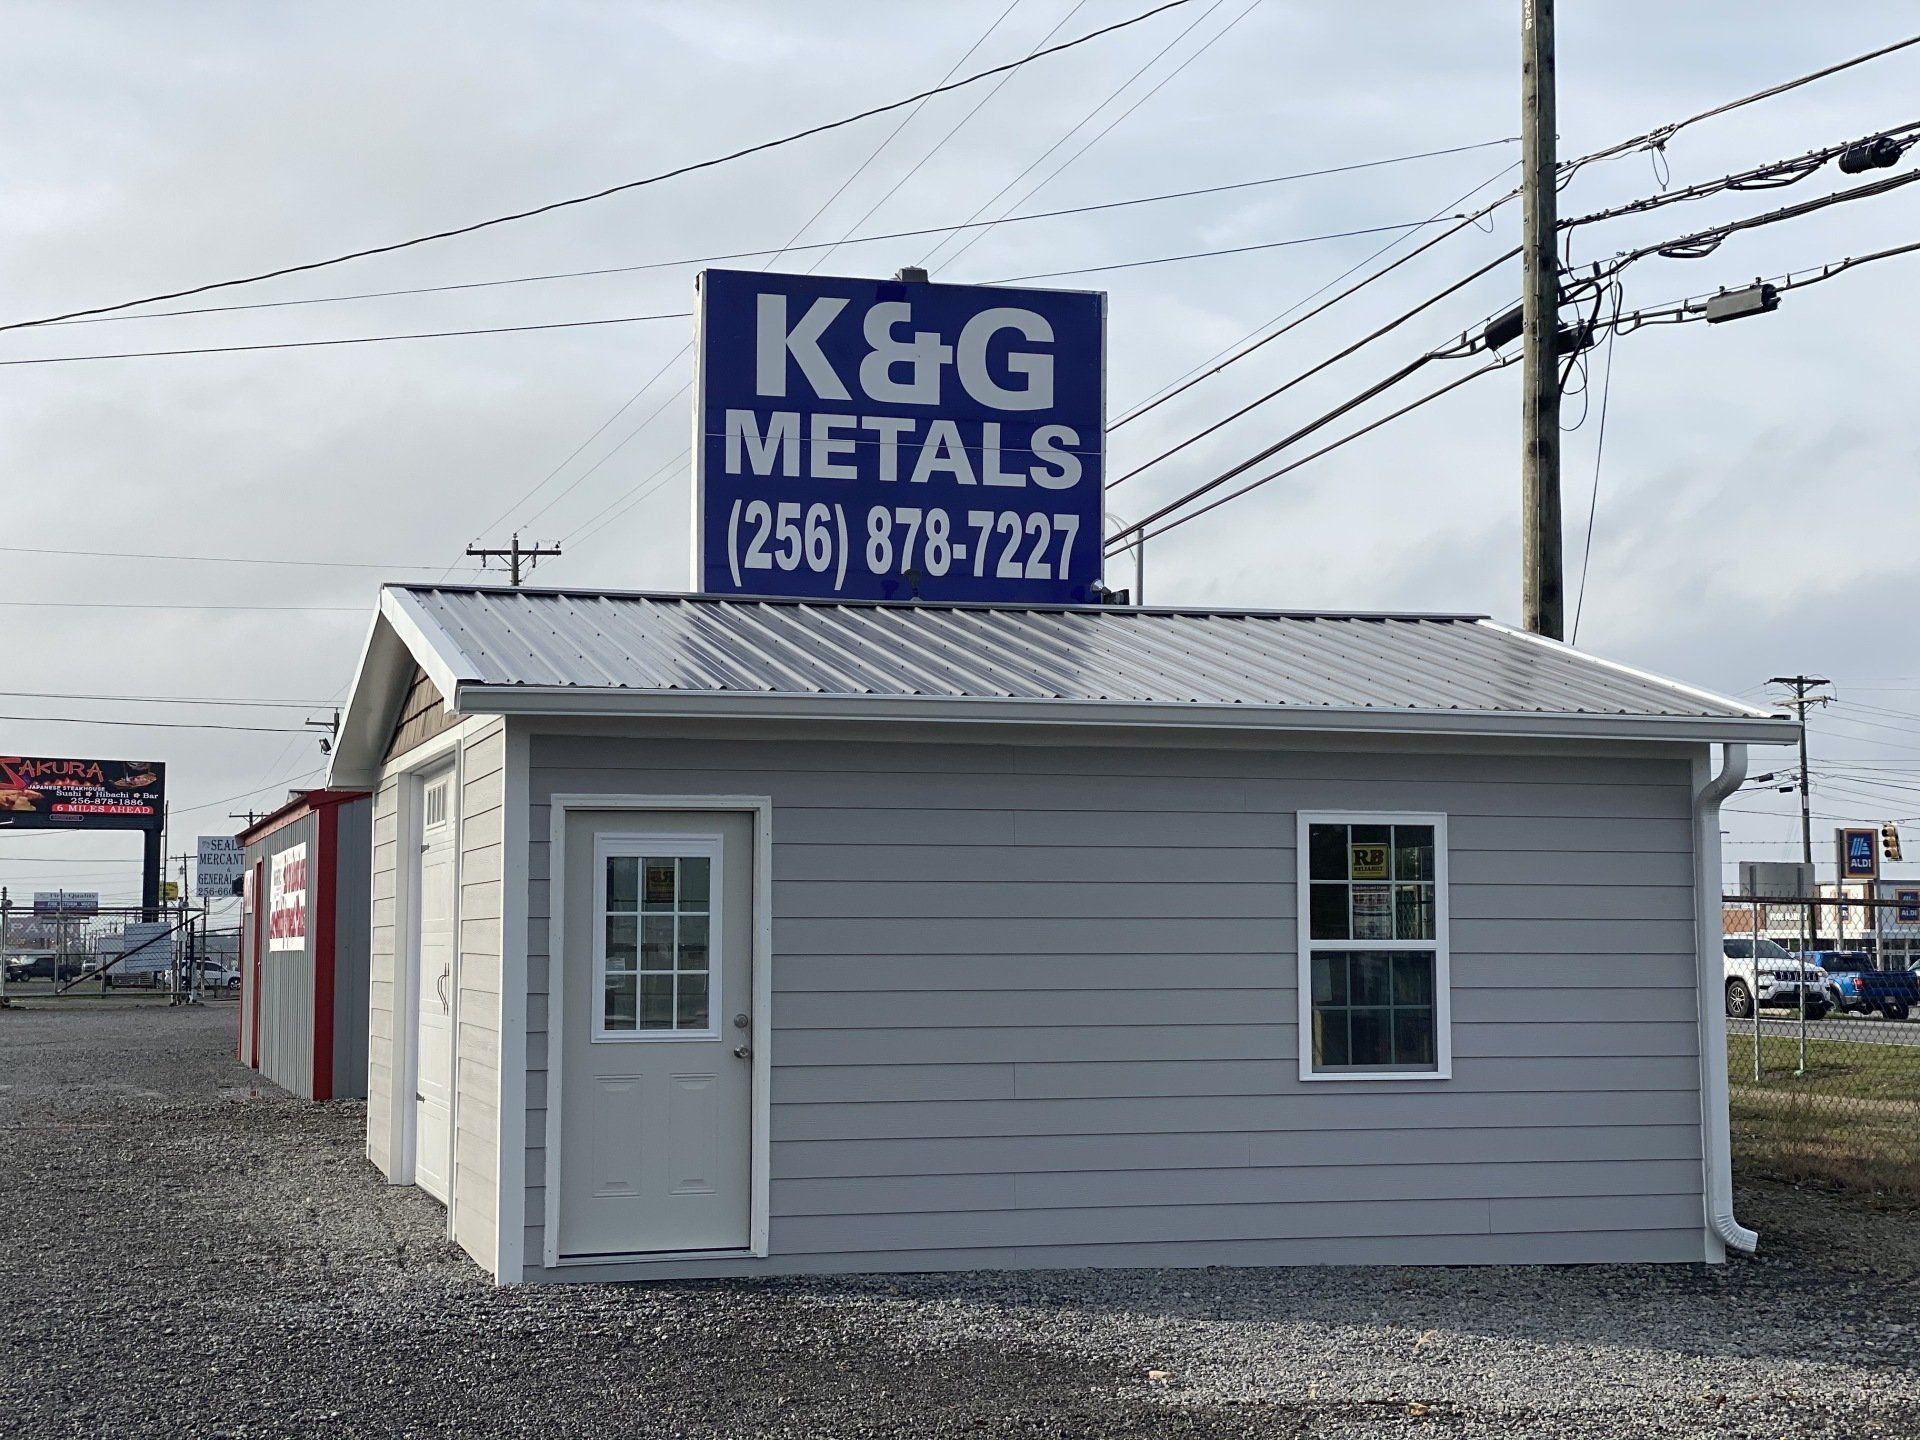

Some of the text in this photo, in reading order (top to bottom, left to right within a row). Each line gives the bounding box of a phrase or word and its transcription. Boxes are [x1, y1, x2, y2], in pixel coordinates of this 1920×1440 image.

[756, 293, 1055, 411] K&G
[725, 408, 1083, 490] METALS
[728, 499, 1080, 591] (256) 878-7227
[0, 757, 104, 790] SAKURA
[68, 805, 105, 813] MILES
[110, 806, 151, 814] AHEAD
[71, 797, 144, 806] 256-878-1886
[1354, 850, 1384, 865] RB
[1850, 858, 1871, 868] ALDI
